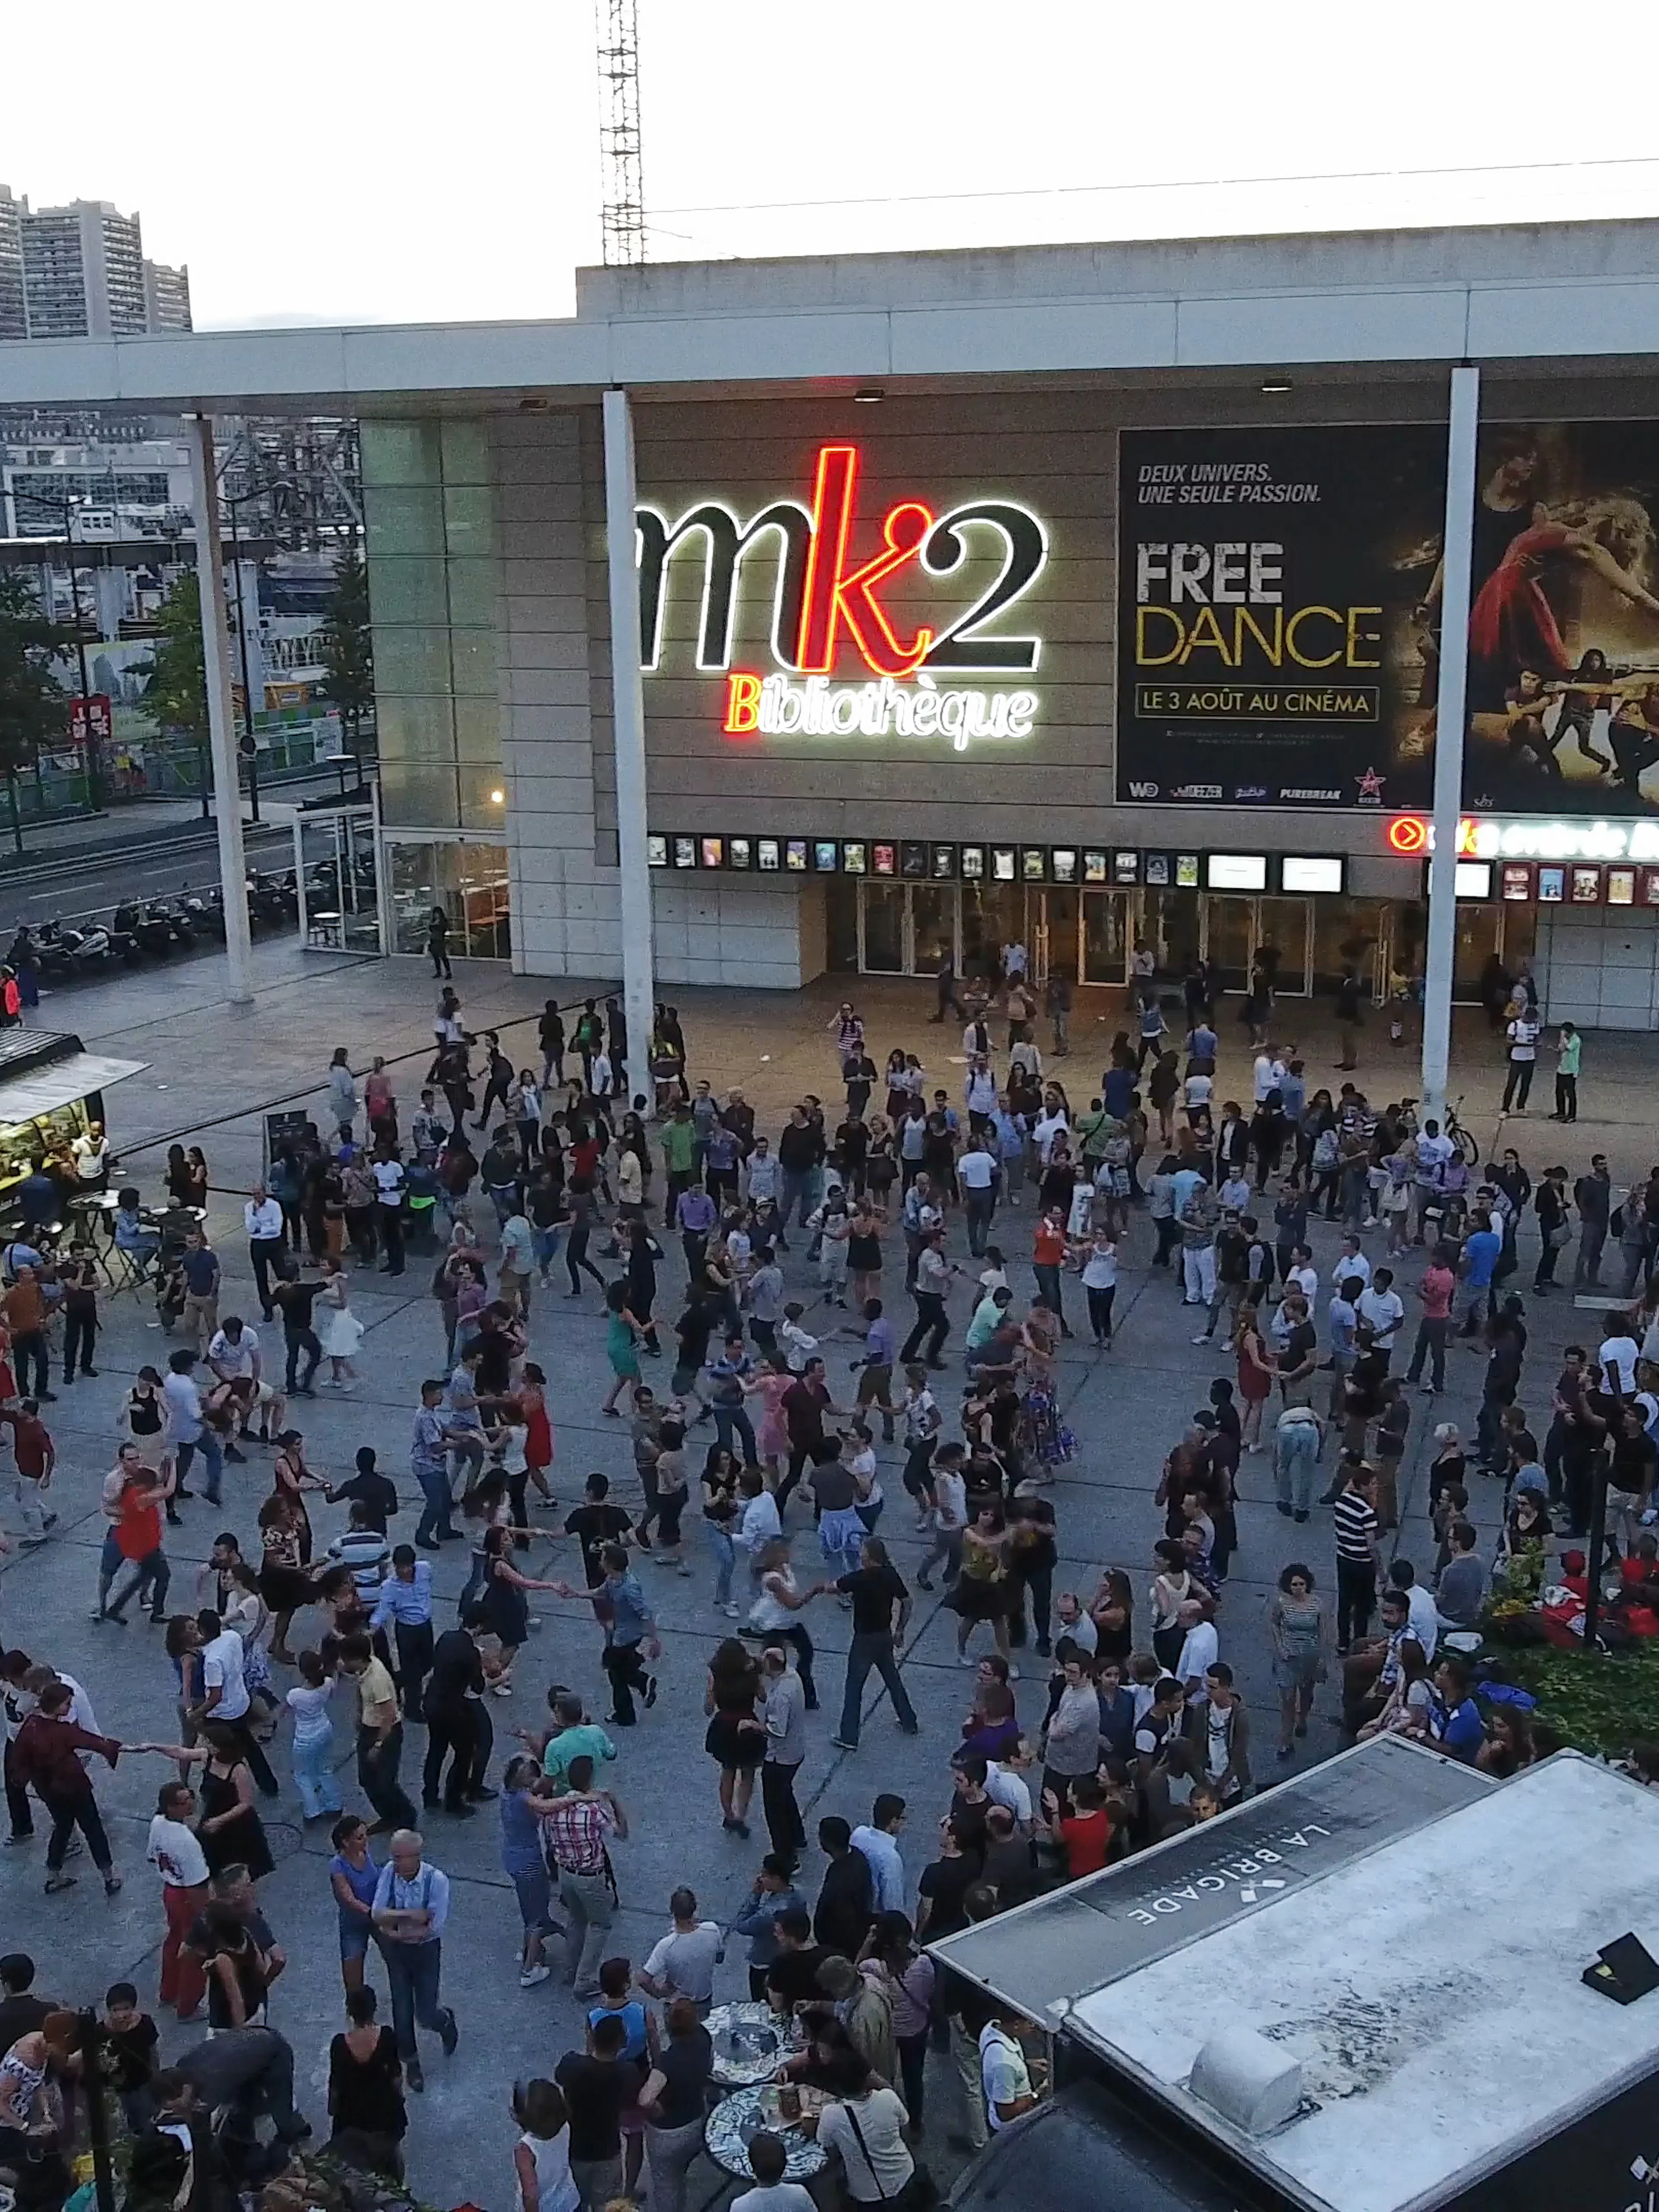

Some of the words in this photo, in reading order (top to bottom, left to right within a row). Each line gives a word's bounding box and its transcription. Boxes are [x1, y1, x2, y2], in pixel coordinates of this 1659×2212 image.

[1138, 464, 1188, 483] DEUX
[1191, 463, 1272, 482] UNIVERS.
[1138, 486, 1176, 504] UNE
[1178, 485, 1236, 504] SEULE
[1238, 483, 1321, 503] PASSION.
[634, 447, 1049, 677] mk2
[1137, 543, 1284, 604] FREE
[1136, 605, 1383, 668] DANCE
[725, 674, 1038, 752] Bibliothèque
[1143, 691, 1163, 709] LE
[1168, 692, 1180, 709] 3
[1186, 688, 1244, 710] AOÛT
[1248, 693, 1278, 711] AU
[1284, 690, 1370, 713] CINÉMA
[1280, 1824, 1331, 1847] LA
[1127, 1848, 1283, 1926] BRIGADE
